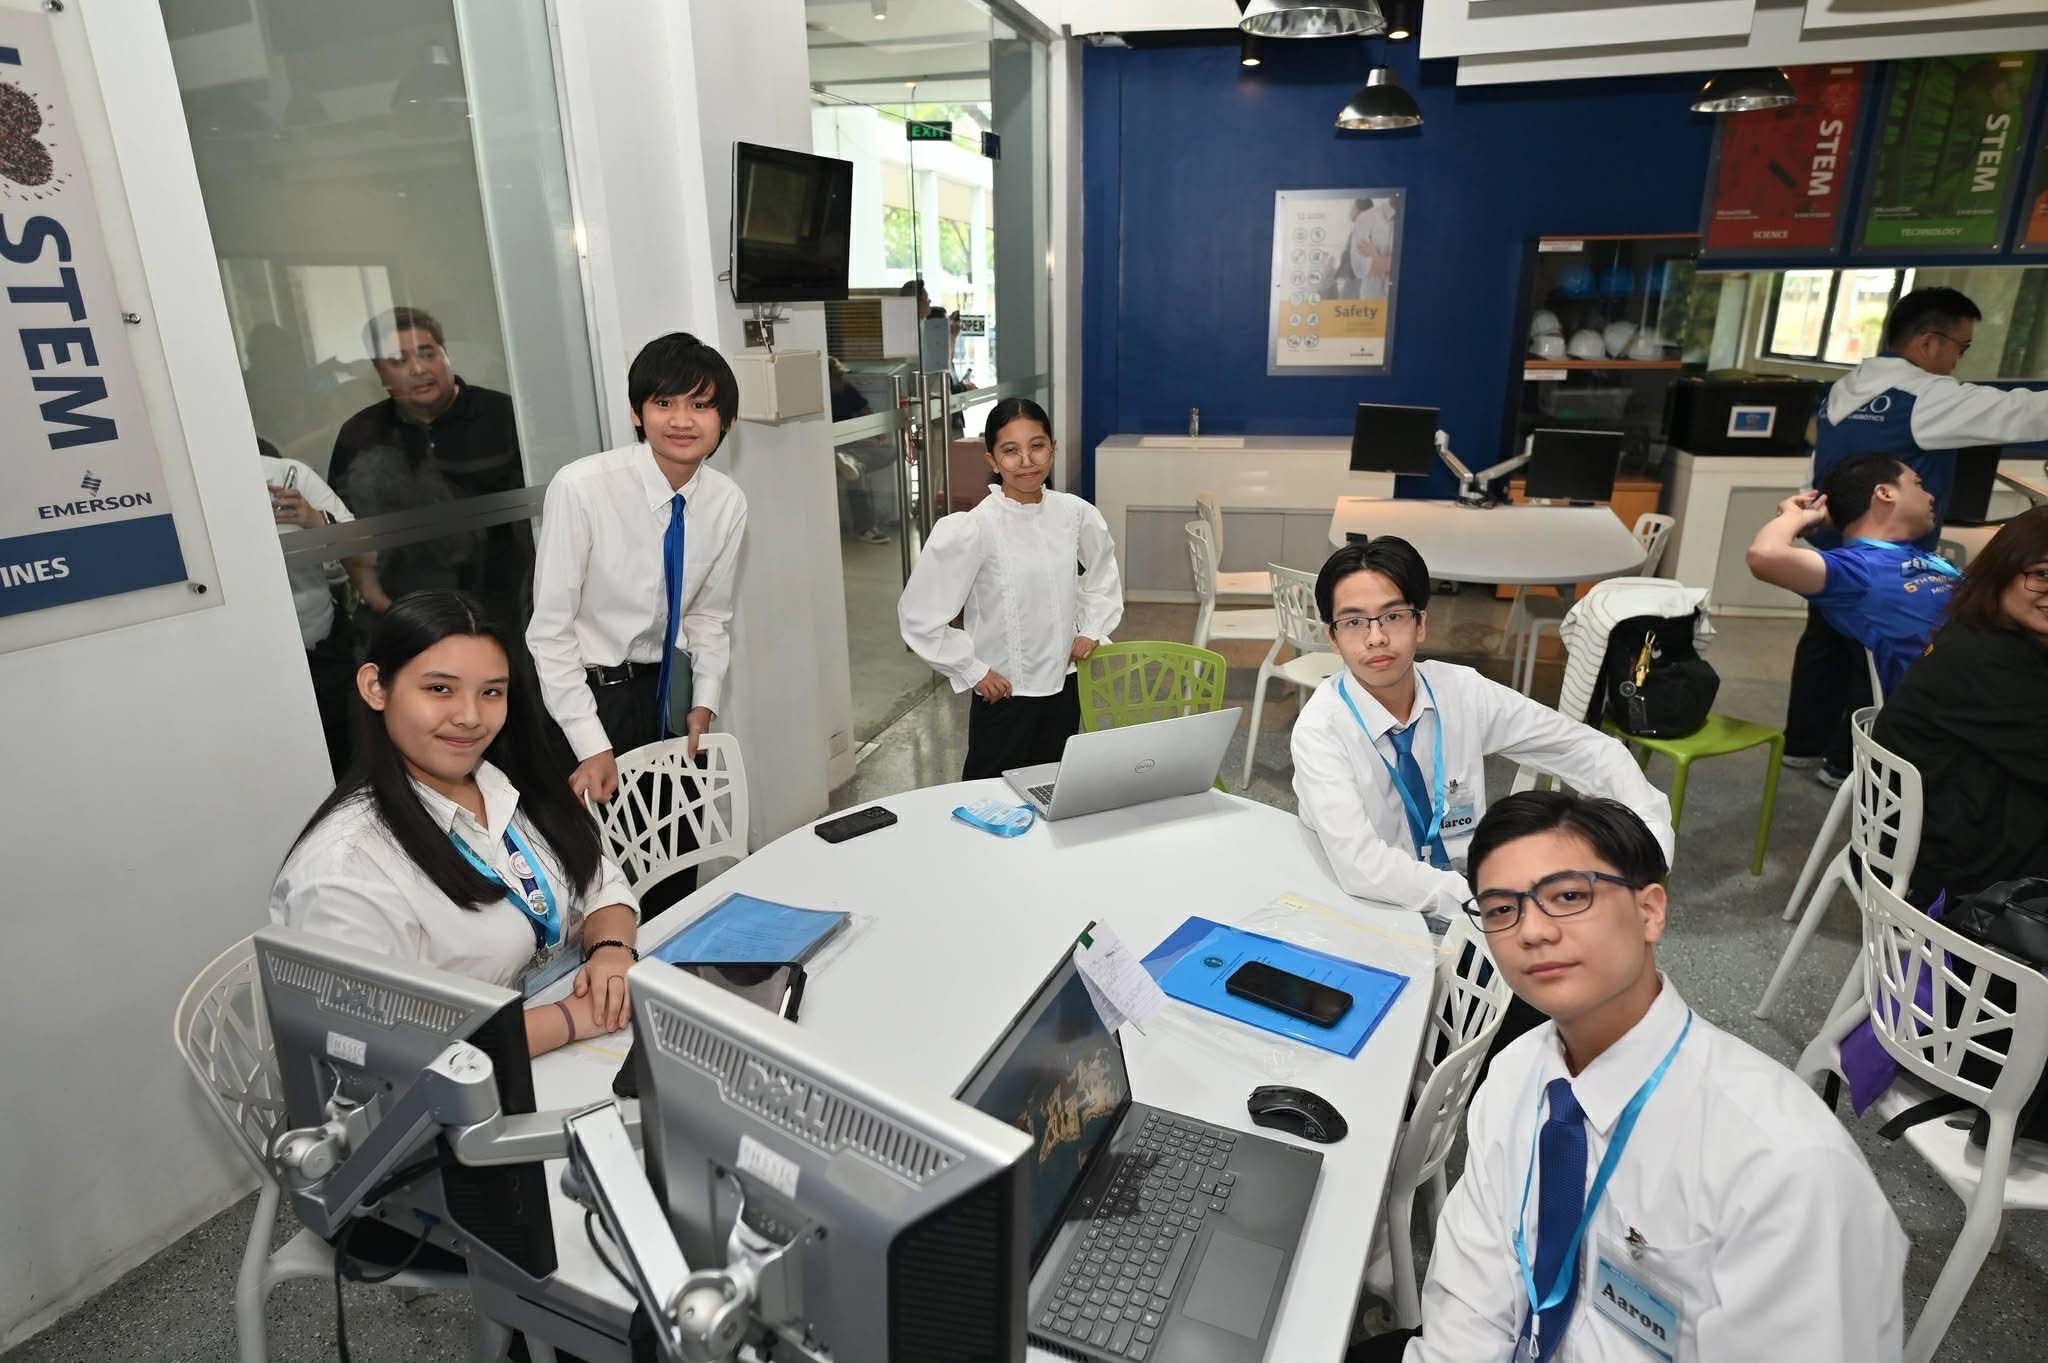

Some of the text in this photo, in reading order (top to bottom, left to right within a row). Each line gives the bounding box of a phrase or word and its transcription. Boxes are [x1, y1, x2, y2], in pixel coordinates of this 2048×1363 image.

[912, 126, 944, 137] EXIT
[1808, 119, 1843, 196] STEM
[1971, 113, 2011, 193] STEM
[1753, 230, 1788, 239] SCIENCE
[1901, 228, 1963, 237] TECHNOLOGY
[1334, 304, 1378, 320] Safety
[0, 213, 119, 451] STEM
[960, 319, 985, 332] OPEN
[38, 491, 153, 520] EMERSON
[1601, 1281, 1666, 1341] Aaron
